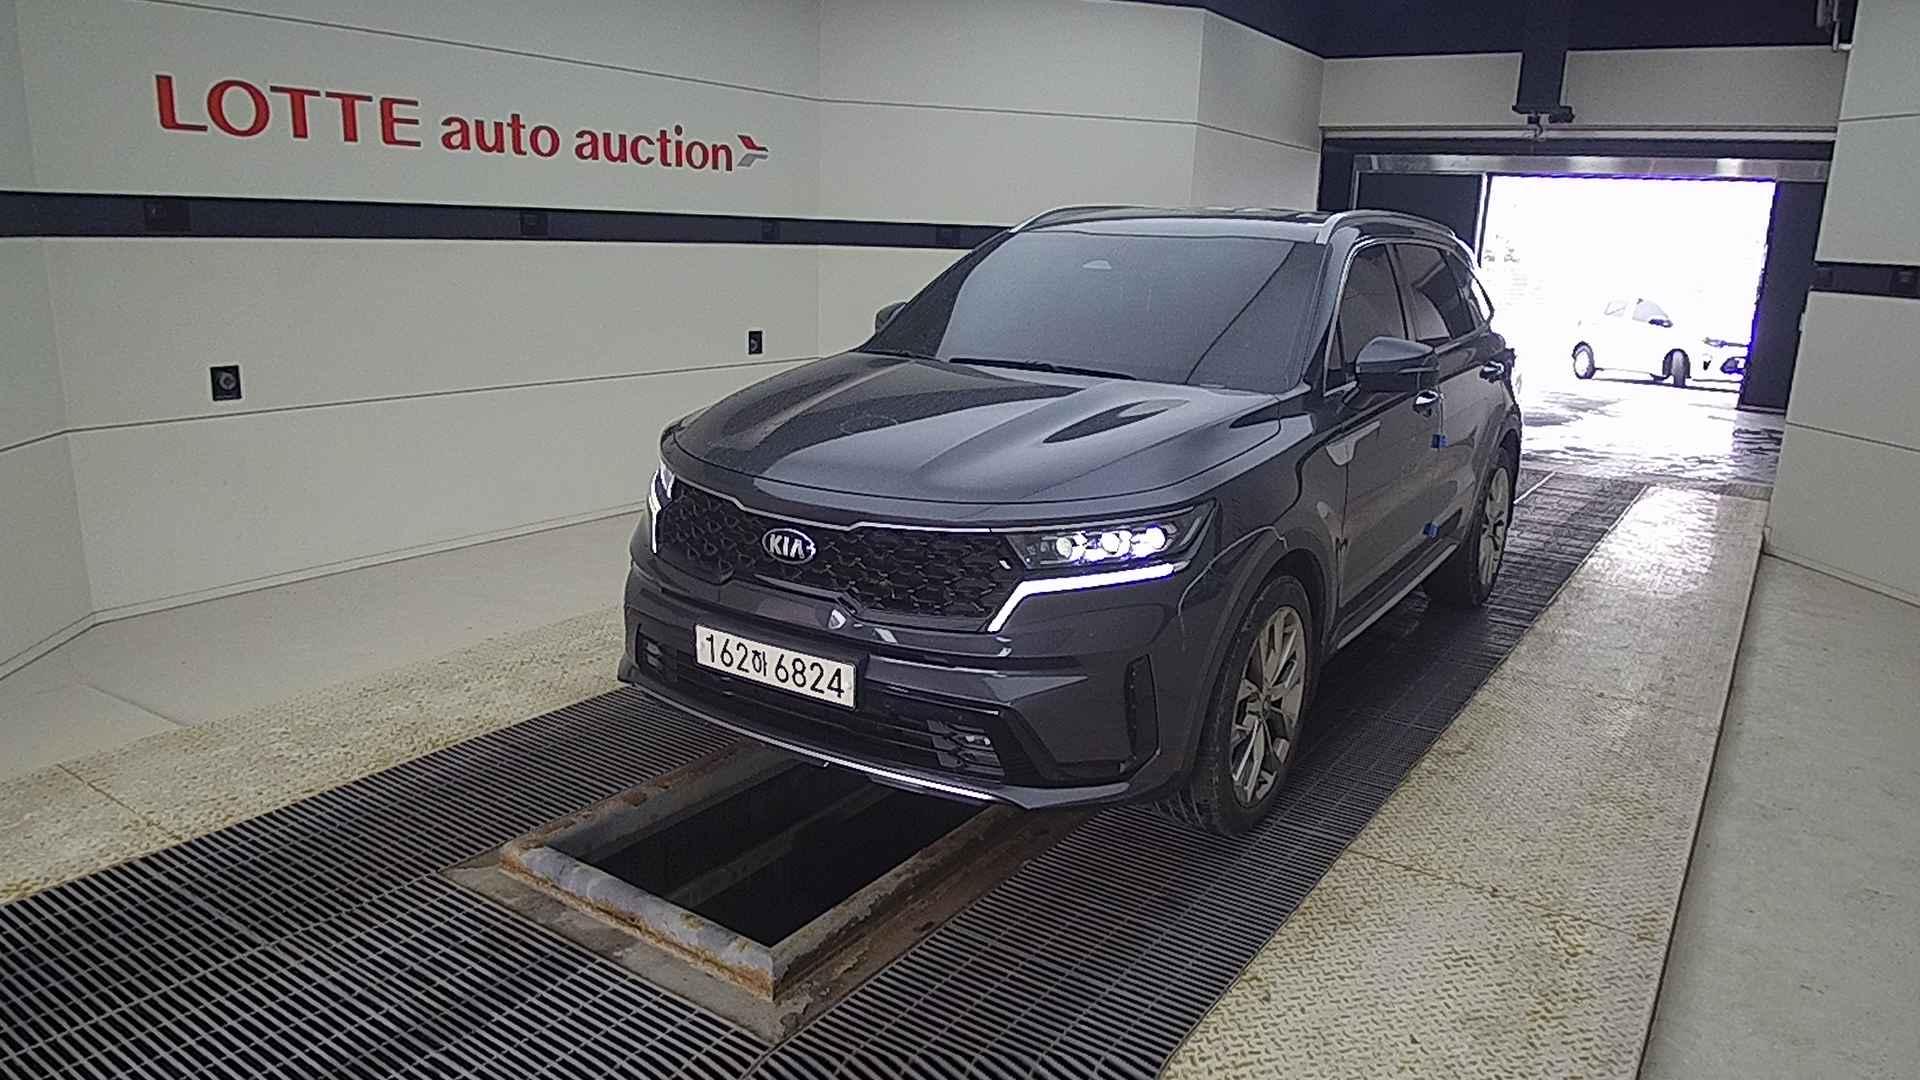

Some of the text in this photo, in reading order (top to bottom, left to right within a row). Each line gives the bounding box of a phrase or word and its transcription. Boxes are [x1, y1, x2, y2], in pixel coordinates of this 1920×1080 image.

[155, 75, 734, 171] LOTTE auto auction
[769, 534, 805, 558] KIA
[705, 634, 845, 698] 162하 6824
